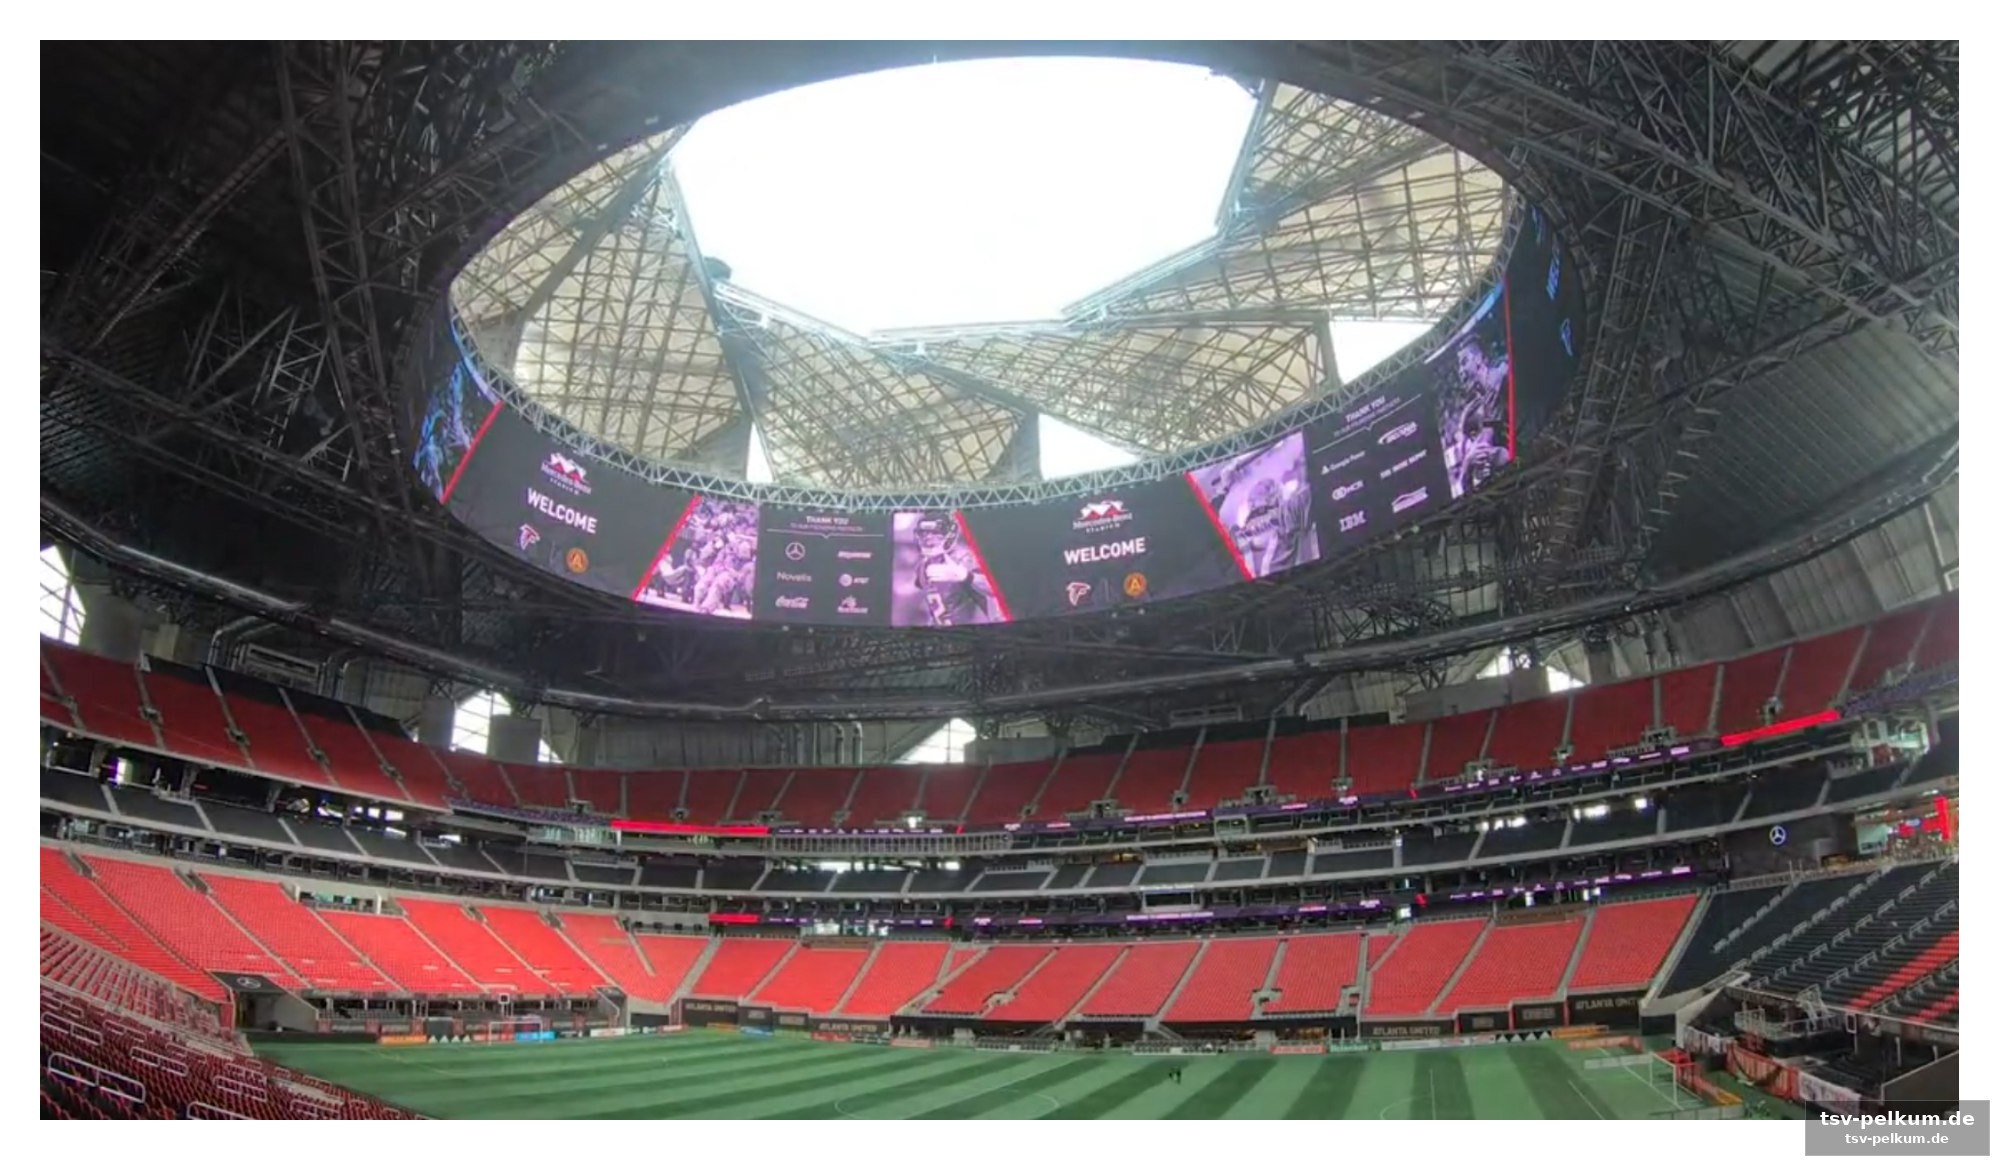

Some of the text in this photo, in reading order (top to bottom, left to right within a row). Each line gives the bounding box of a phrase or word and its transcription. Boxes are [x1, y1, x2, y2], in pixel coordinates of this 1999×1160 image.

[527, 487, 598, 534] WELCOME
[1339, 510, 1367, 532] IBM
[1063, 537, 1147, 566] WELCOME
